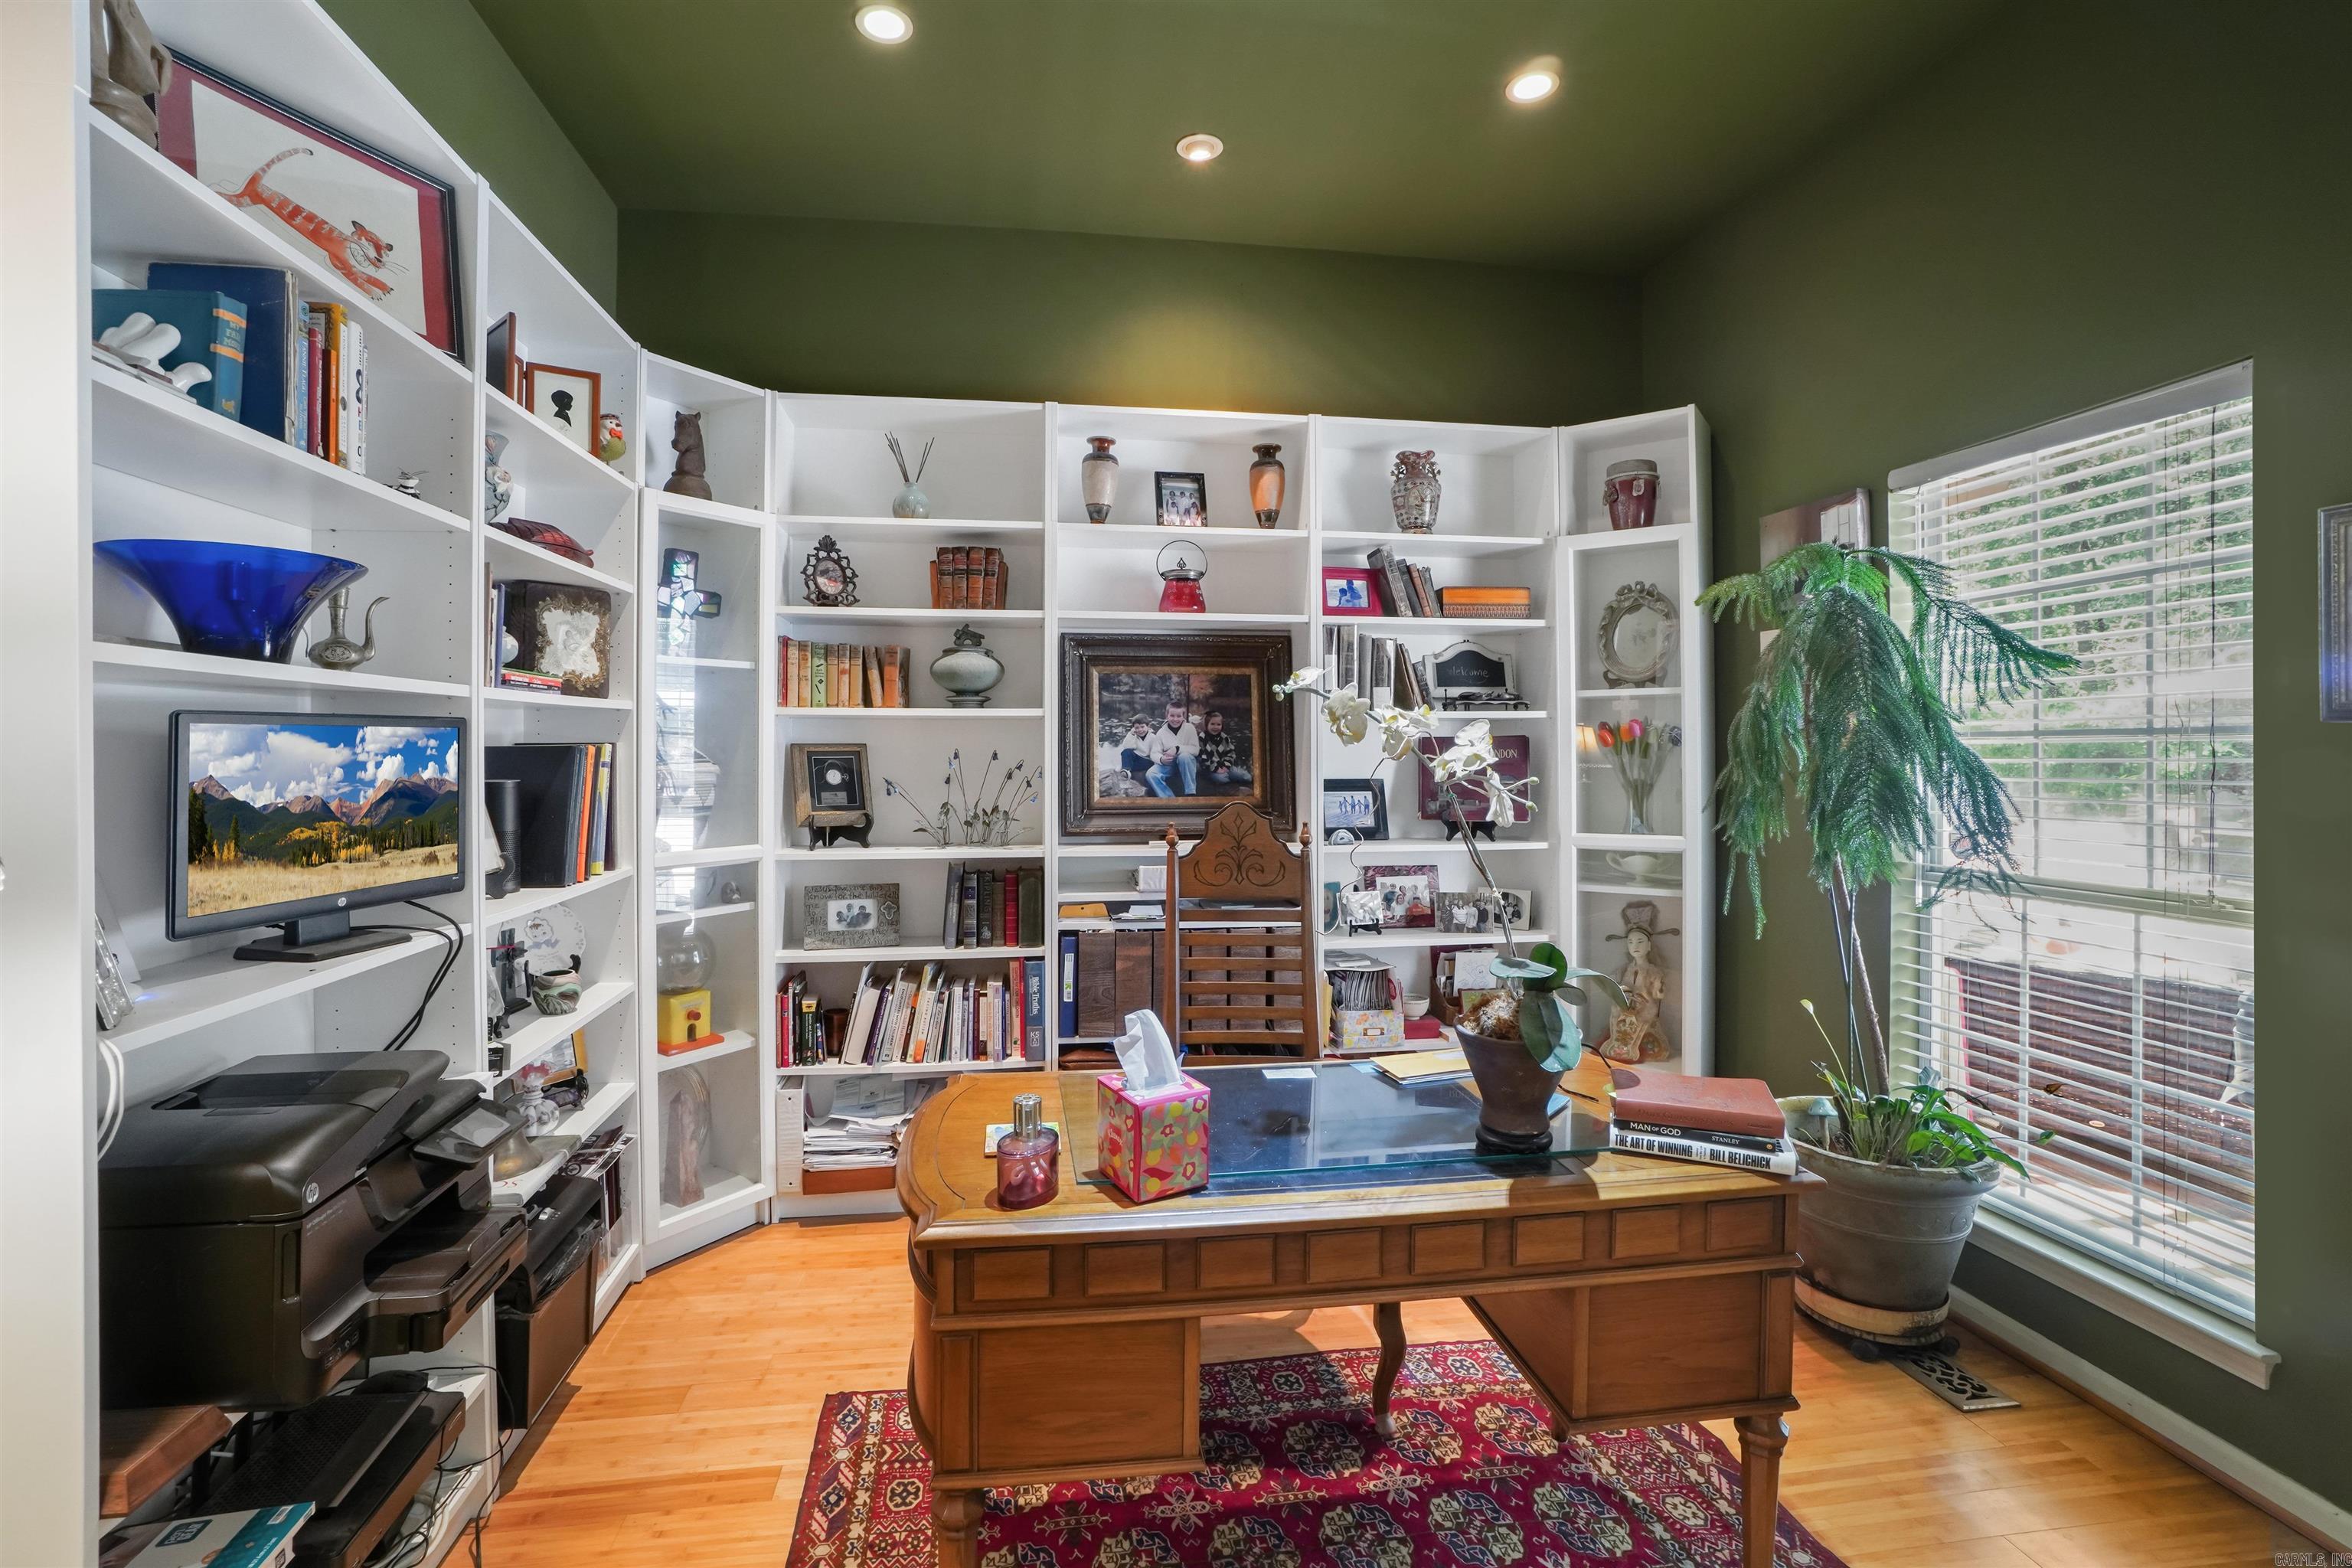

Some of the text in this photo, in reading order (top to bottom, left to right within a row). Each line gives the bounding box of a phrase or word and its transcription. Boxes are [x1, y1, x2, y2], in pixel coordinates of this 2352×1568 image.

[983, 877, 991, 913] KIPLING
[897, 988, 905, 1014] ENCOUNTERS
[1630, 1122, 1651, 1132] MAN
[1660, 1126, 1681, 1136] GOD
[1711, 1136, 1740, 1145] STANLEY
[1615, 1134, 1628, 1148] THE
[1629, 1136, 1645, 1150] ART
[1646, 1138, 1656, 1152] OF
[1657, 1141, 1693, 1158] WINNING
[1710, 1149, 1726, 1163] BILL
[1728, 1152, 1771, 1170] BELICHICK
